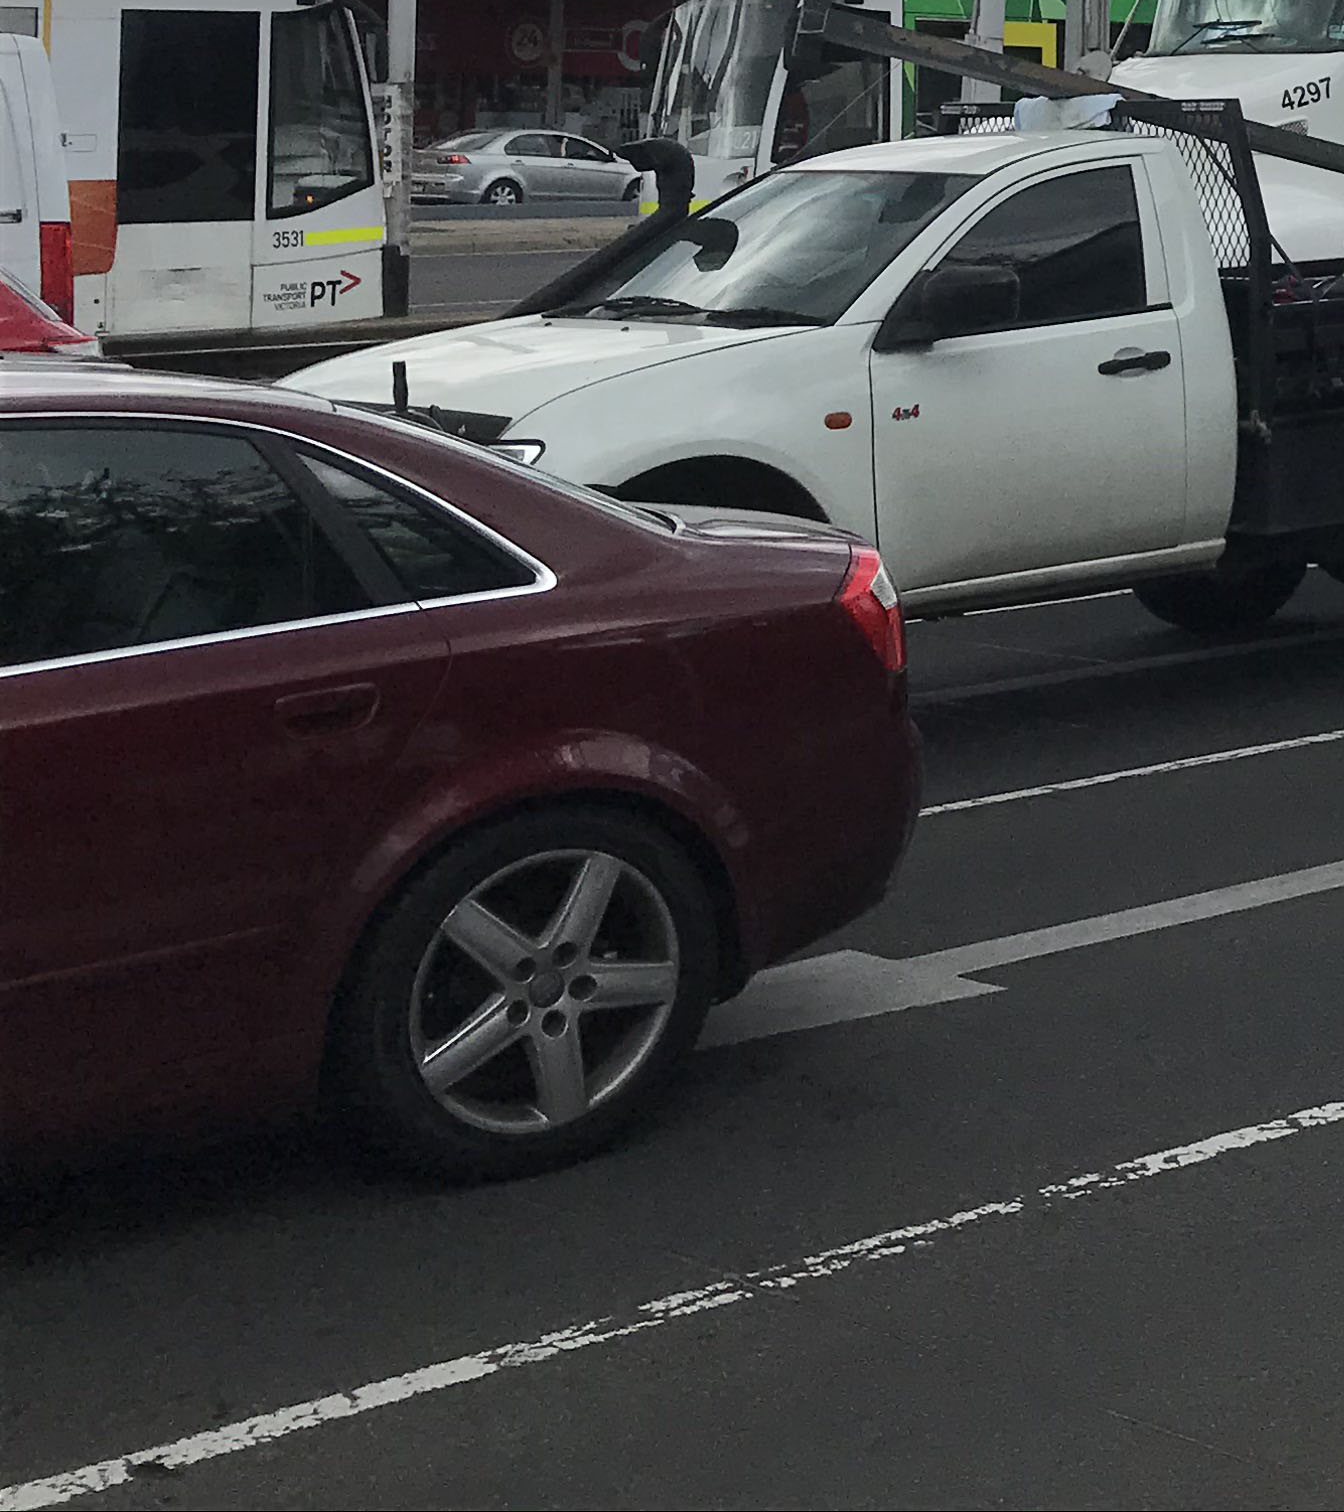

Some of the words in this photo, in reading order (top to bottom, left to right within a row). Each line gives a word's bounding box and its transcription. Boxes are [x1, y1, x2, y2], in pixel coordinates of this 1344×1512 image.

[1280, 76, 1332, 112] 4297
[272, 230, 304, 249] 3531
[263, 292, 306, 302] TRANSPORT
[310, 280, 342, 307] PT
